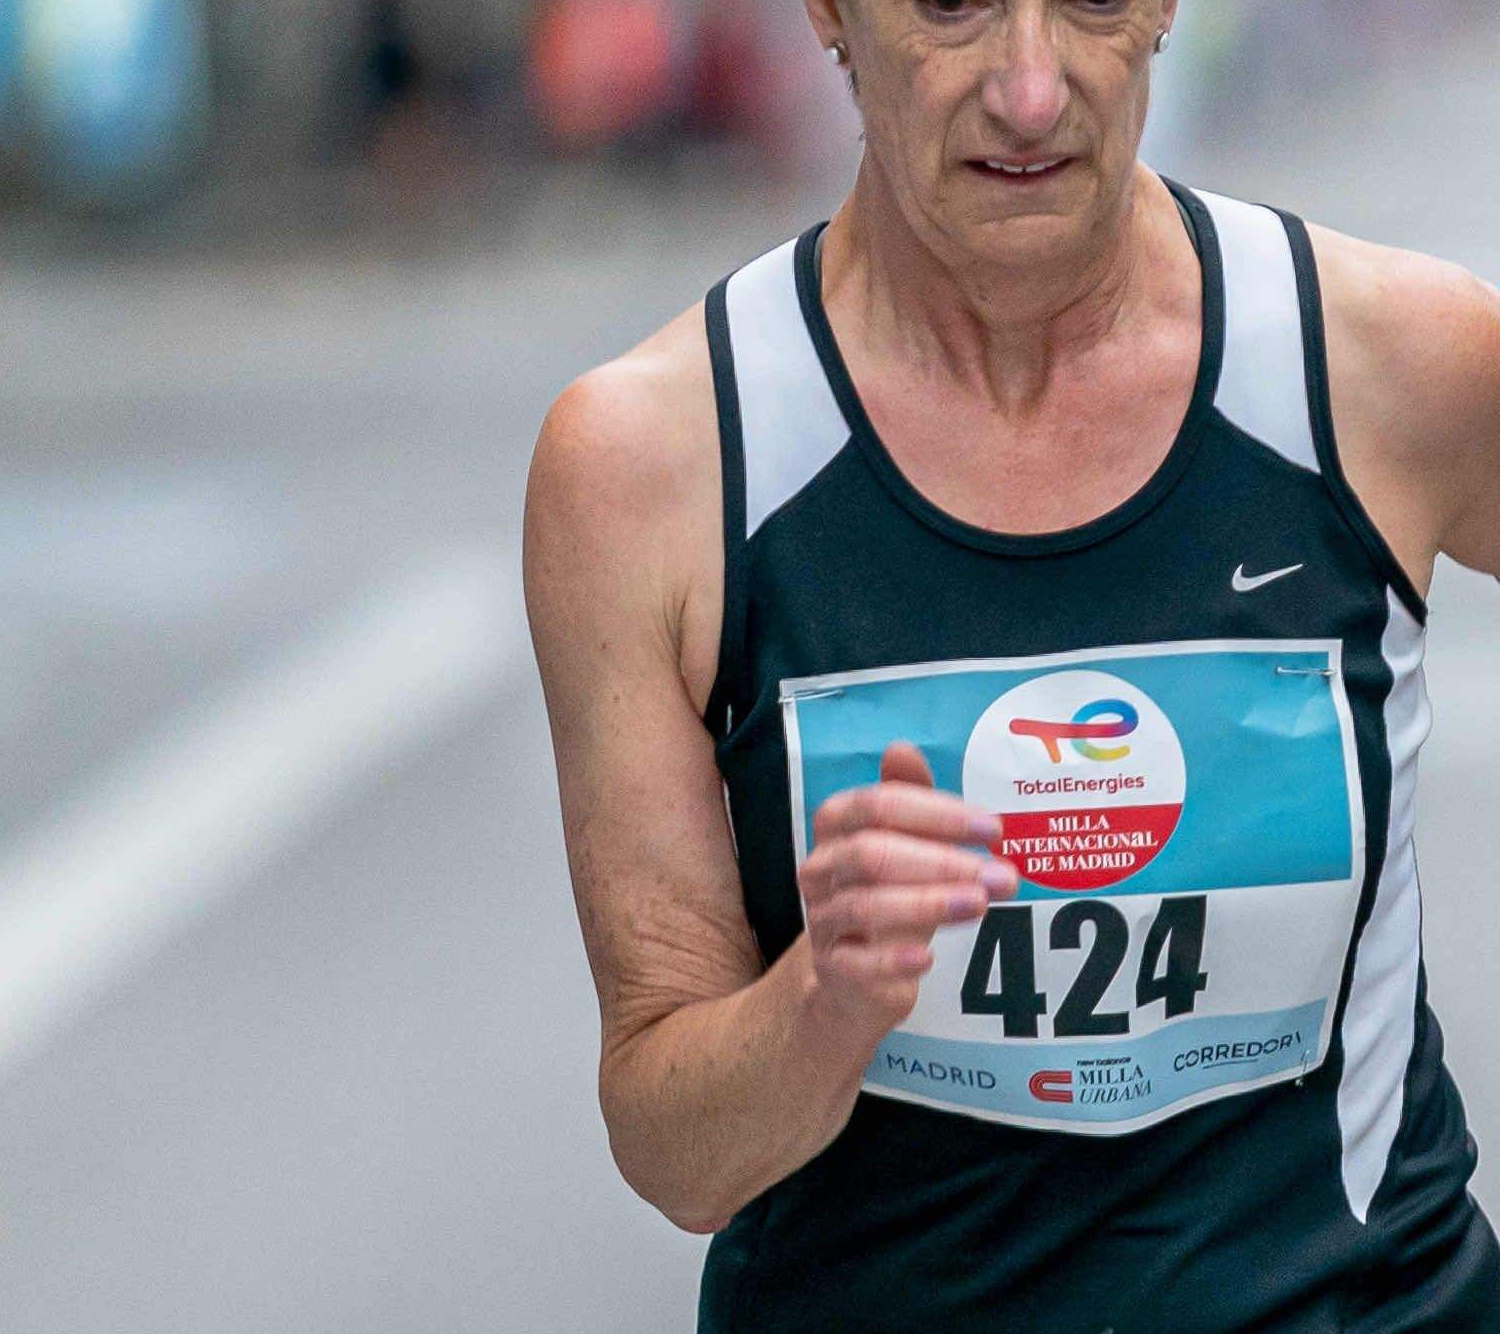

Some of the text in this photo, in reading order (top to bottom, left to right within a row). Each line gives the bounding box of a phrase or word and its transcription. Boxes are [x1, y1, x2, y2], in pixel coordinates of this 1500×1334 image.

[1013, 773, 1145, 795] TotalEnergies
[1048, 815, 1110, 832] MILLA
[1027, 852, 1136, 873] DE MADRID
[961, 894, 1209, 1039] 424
[886, 1053, 997, 1090] MADRID
[1079, 1064, 1145, 1085] MILLA
[1079, 1079, 1152, 1104] URBANA
